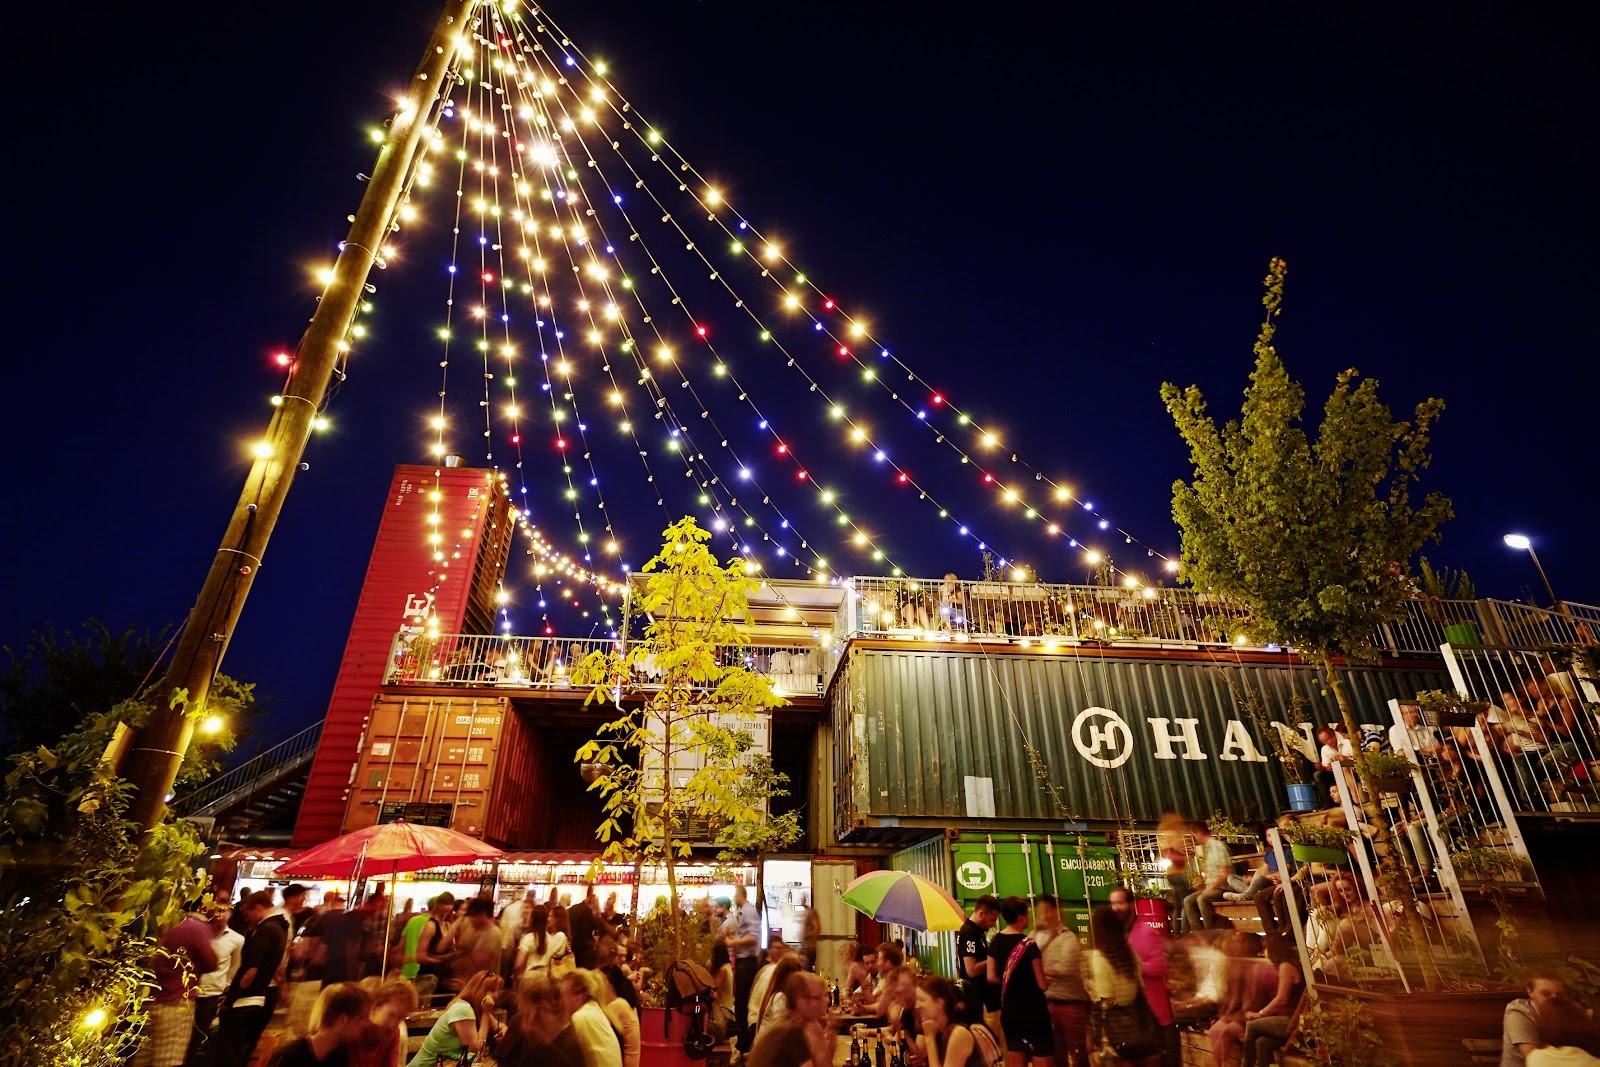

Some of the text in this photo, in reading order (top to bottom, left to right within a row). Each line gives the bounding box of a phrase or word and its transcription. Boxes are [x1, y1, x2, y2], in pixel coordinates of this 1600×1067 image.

[1060, 858, 1082, 870] EMCU
[1086, 875, 1105, 887] 22G1
[966, 940, 976, 954] 35
